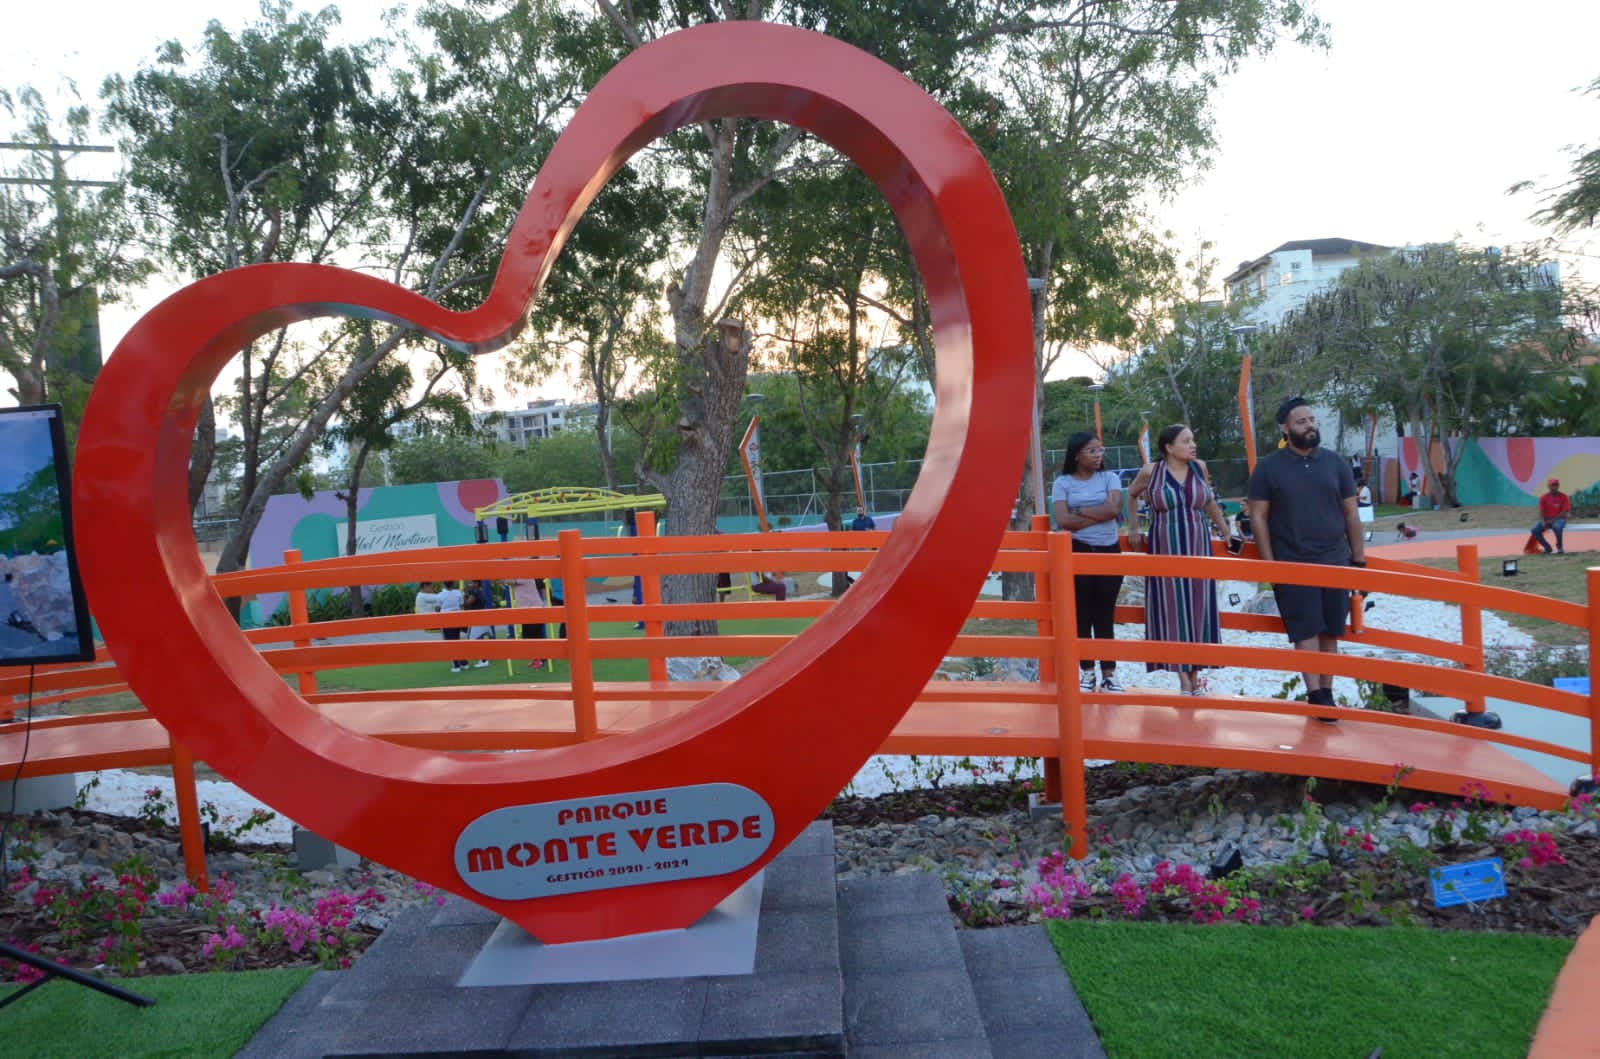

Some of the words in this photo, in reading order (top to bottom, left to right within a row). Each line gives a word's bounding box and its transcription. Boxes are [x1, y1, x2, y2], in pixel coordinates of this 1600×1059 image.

[558, 799, 667, 825] PARQUE
[467, 832, 617, 873] MONTE
[630, 815, 761, 853] VERDE
[546, 867, 605, 883] GESTIÓN
[608, 864, 643, 876] 2020
[654, 858, 689, 870] 2024
